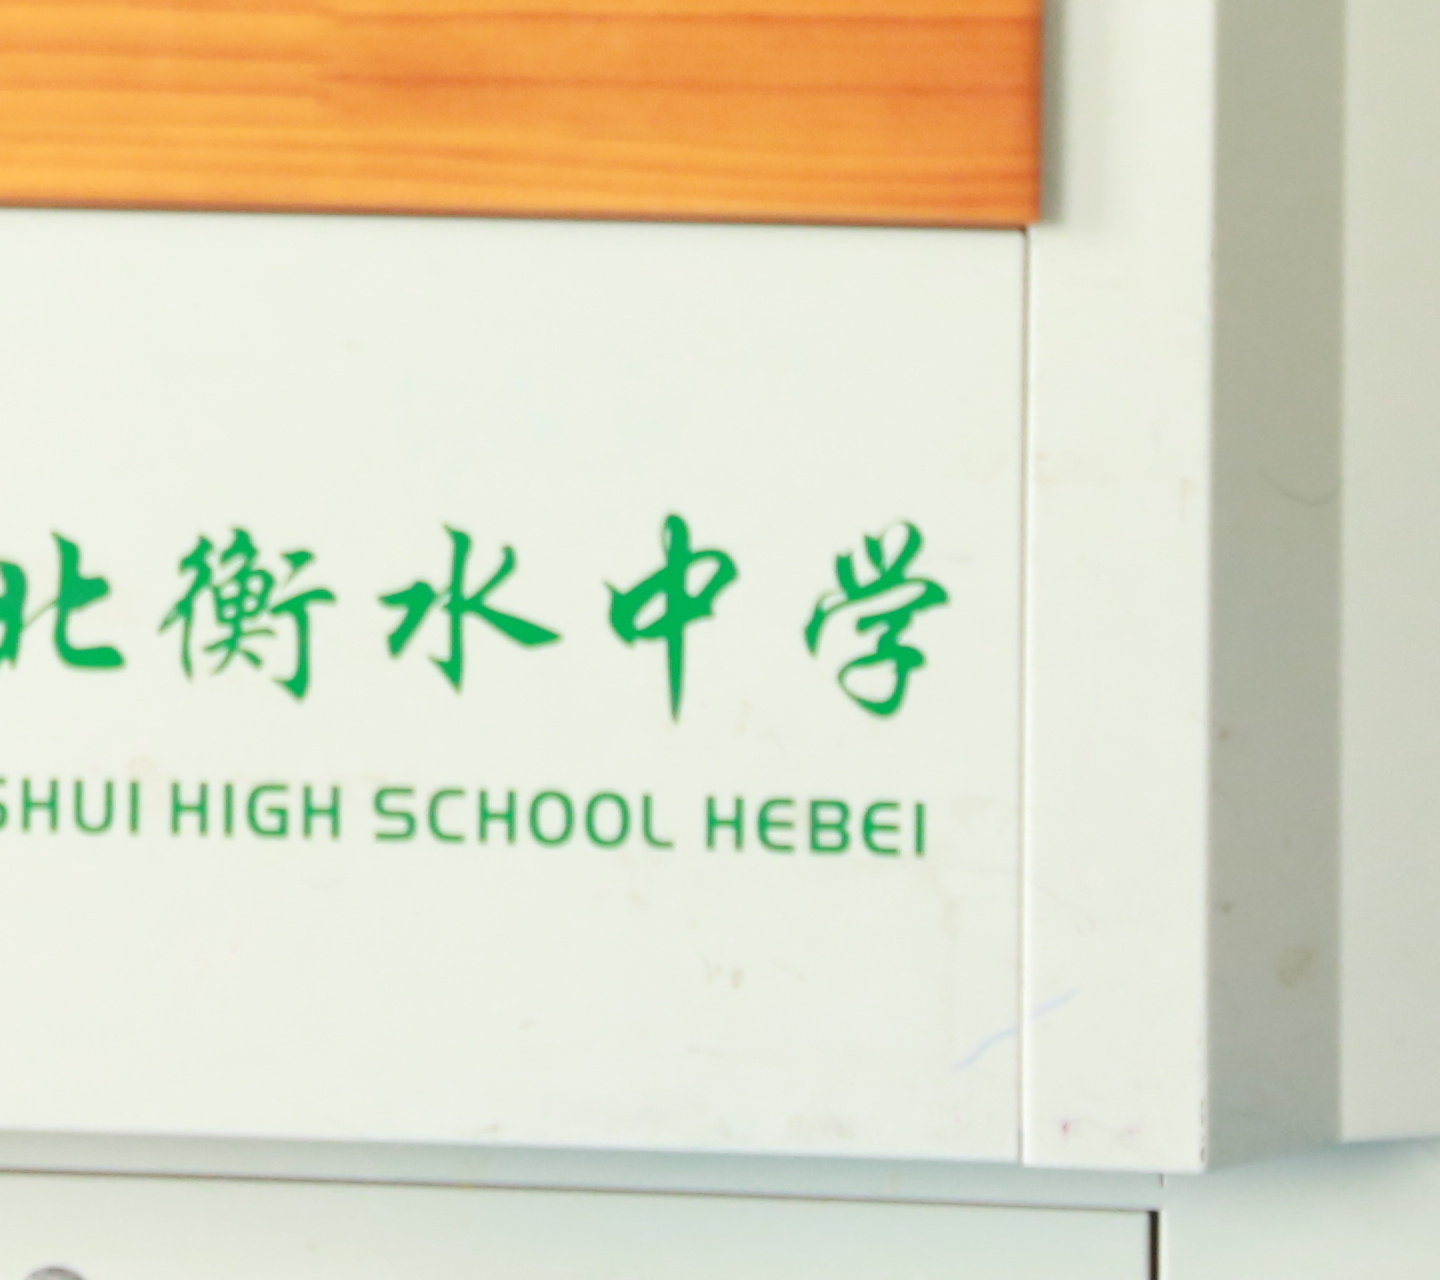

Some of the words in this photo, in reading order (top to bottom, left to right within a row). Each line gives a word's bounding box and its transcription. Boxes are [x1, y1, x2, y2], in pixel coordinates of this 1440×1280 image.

[170, 781, 342, 841] HIGH
[373, 786, 674, 850] SCHOOL
[705, 795, 927, 858] HEBEI
